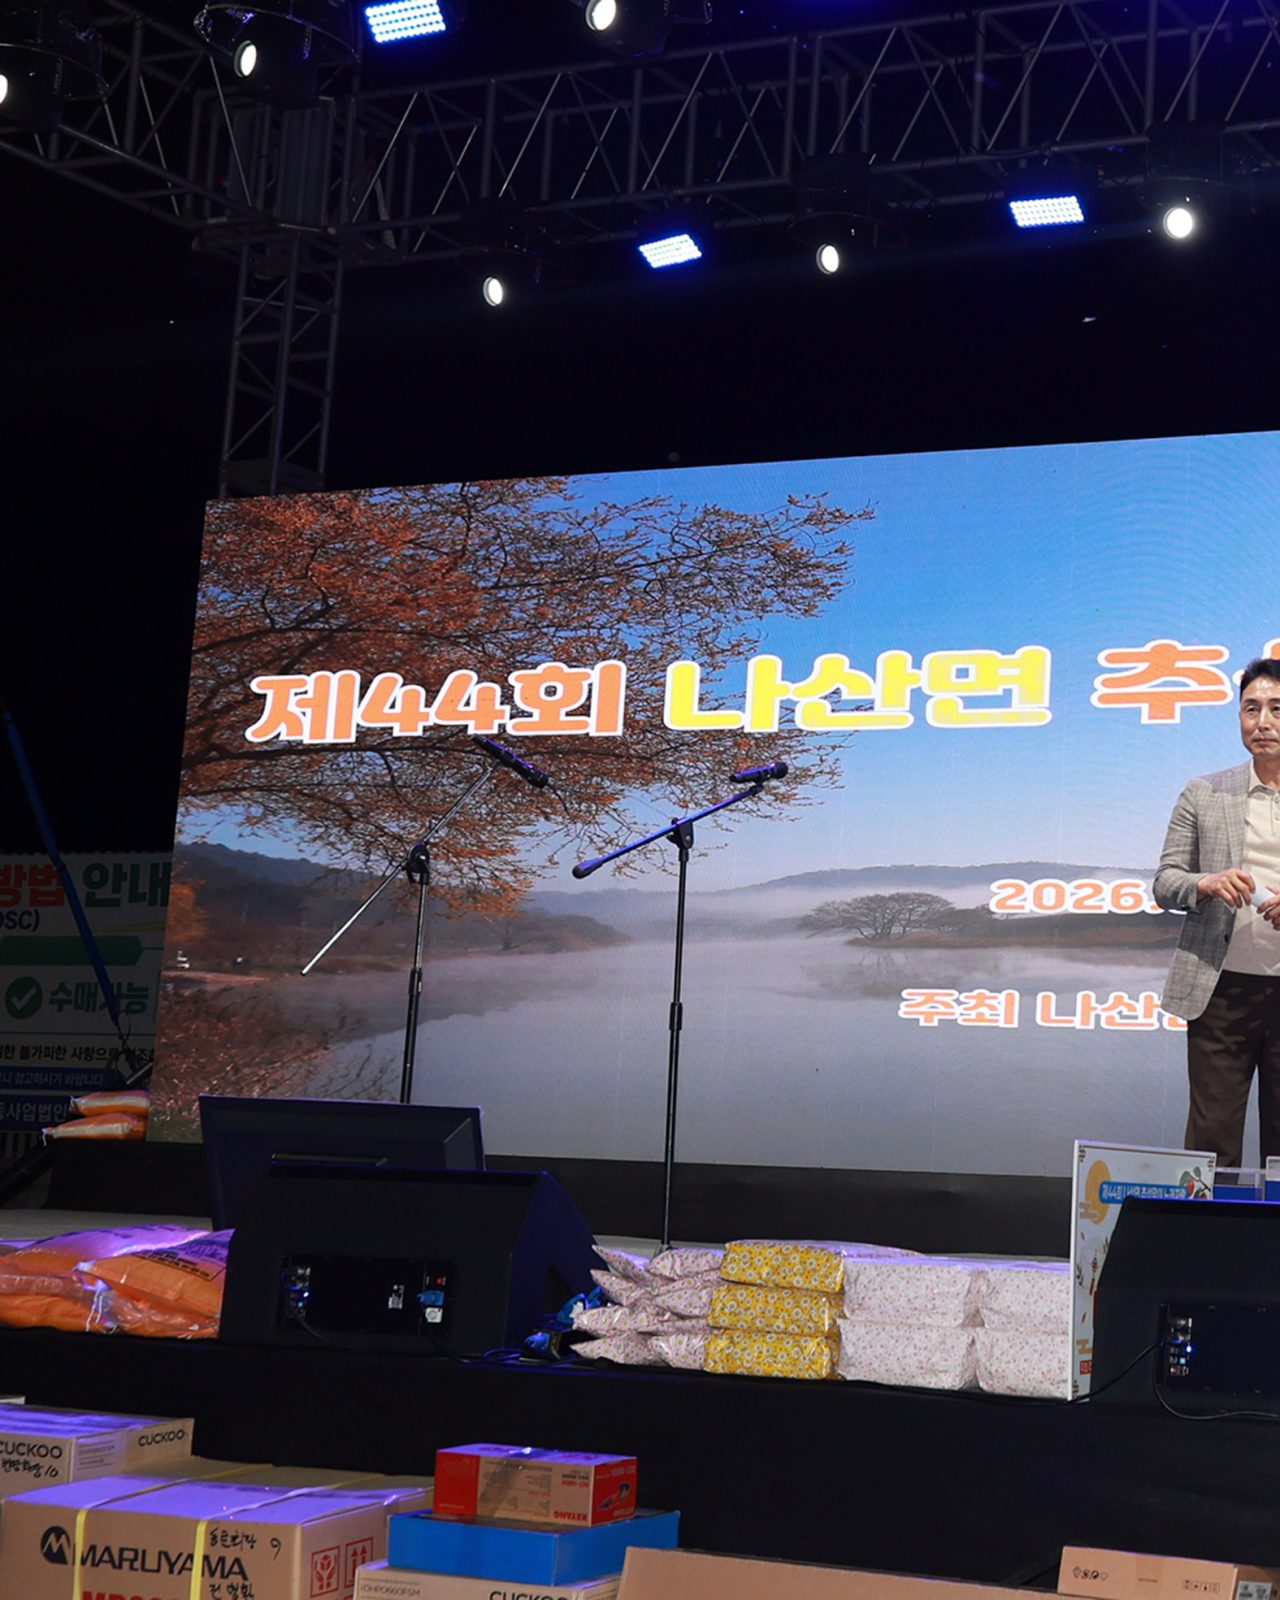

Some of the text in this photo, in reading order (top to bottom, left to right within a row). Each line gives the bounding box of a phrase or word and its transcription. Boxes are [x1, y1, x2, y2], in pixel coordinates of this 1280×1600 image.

[244, 659, 627, 744] 제44회
[663, 645, 1052, 733] 나산면
[82, 862, 172, 907] 안내
[989, 878, 1176, 914] 2026.
[0, 908, 40, 932] SC)
[898, 987, 1018, 1028] 주최
[1036, 991, 1188, 1031] 나산
[138, 1428, 185, 1447] CUCKOO
[72, 1542, 249, 1581] MARUYAMA
[270, 1537, 281, 1560] 9
